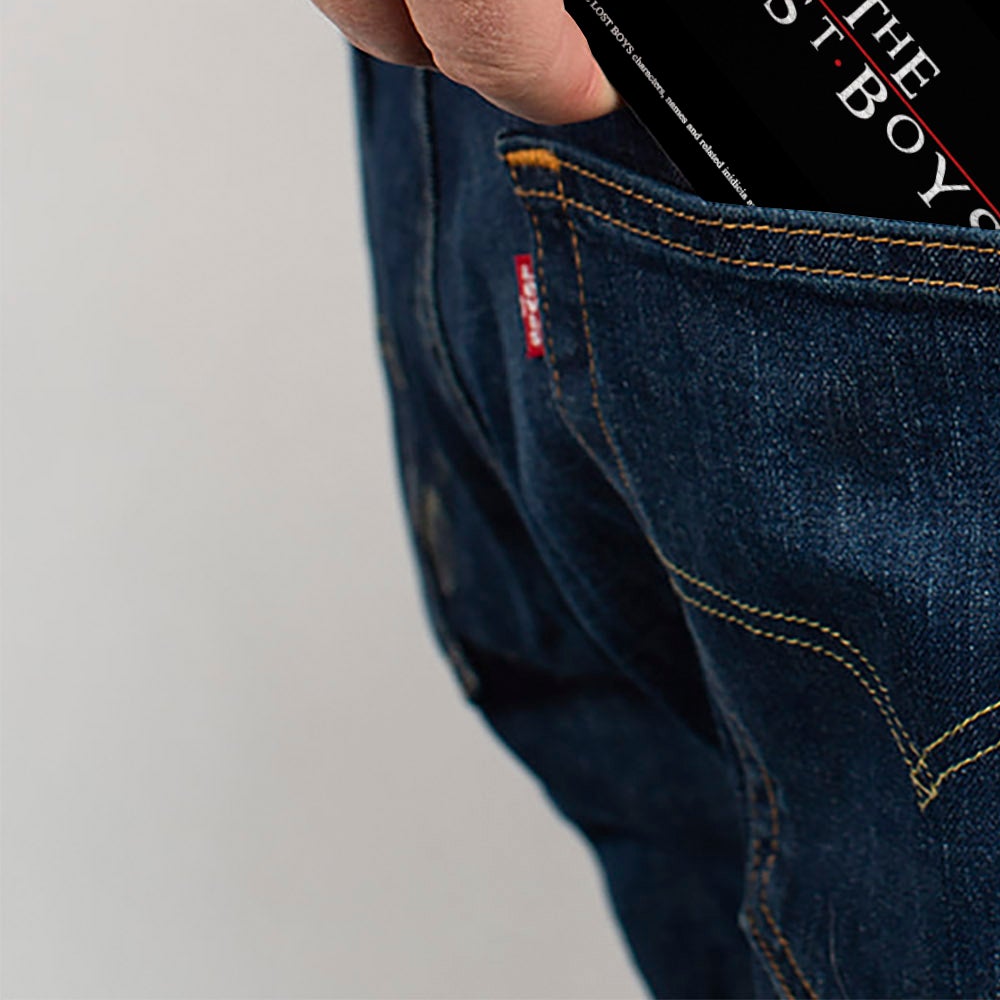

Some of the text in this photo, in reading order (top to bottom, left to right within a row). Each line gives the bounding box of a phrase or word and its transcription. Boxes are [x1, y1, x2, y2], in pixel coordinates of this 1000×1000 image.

[589, 0, 613, 26] LOST
[609, 25, 634, 54] BOYS
[631, 53, 665, 98] characters,
[664, 96, 688, 124] names
[685, 122, 702, 140] and
[698, 138, 725, 169] related
